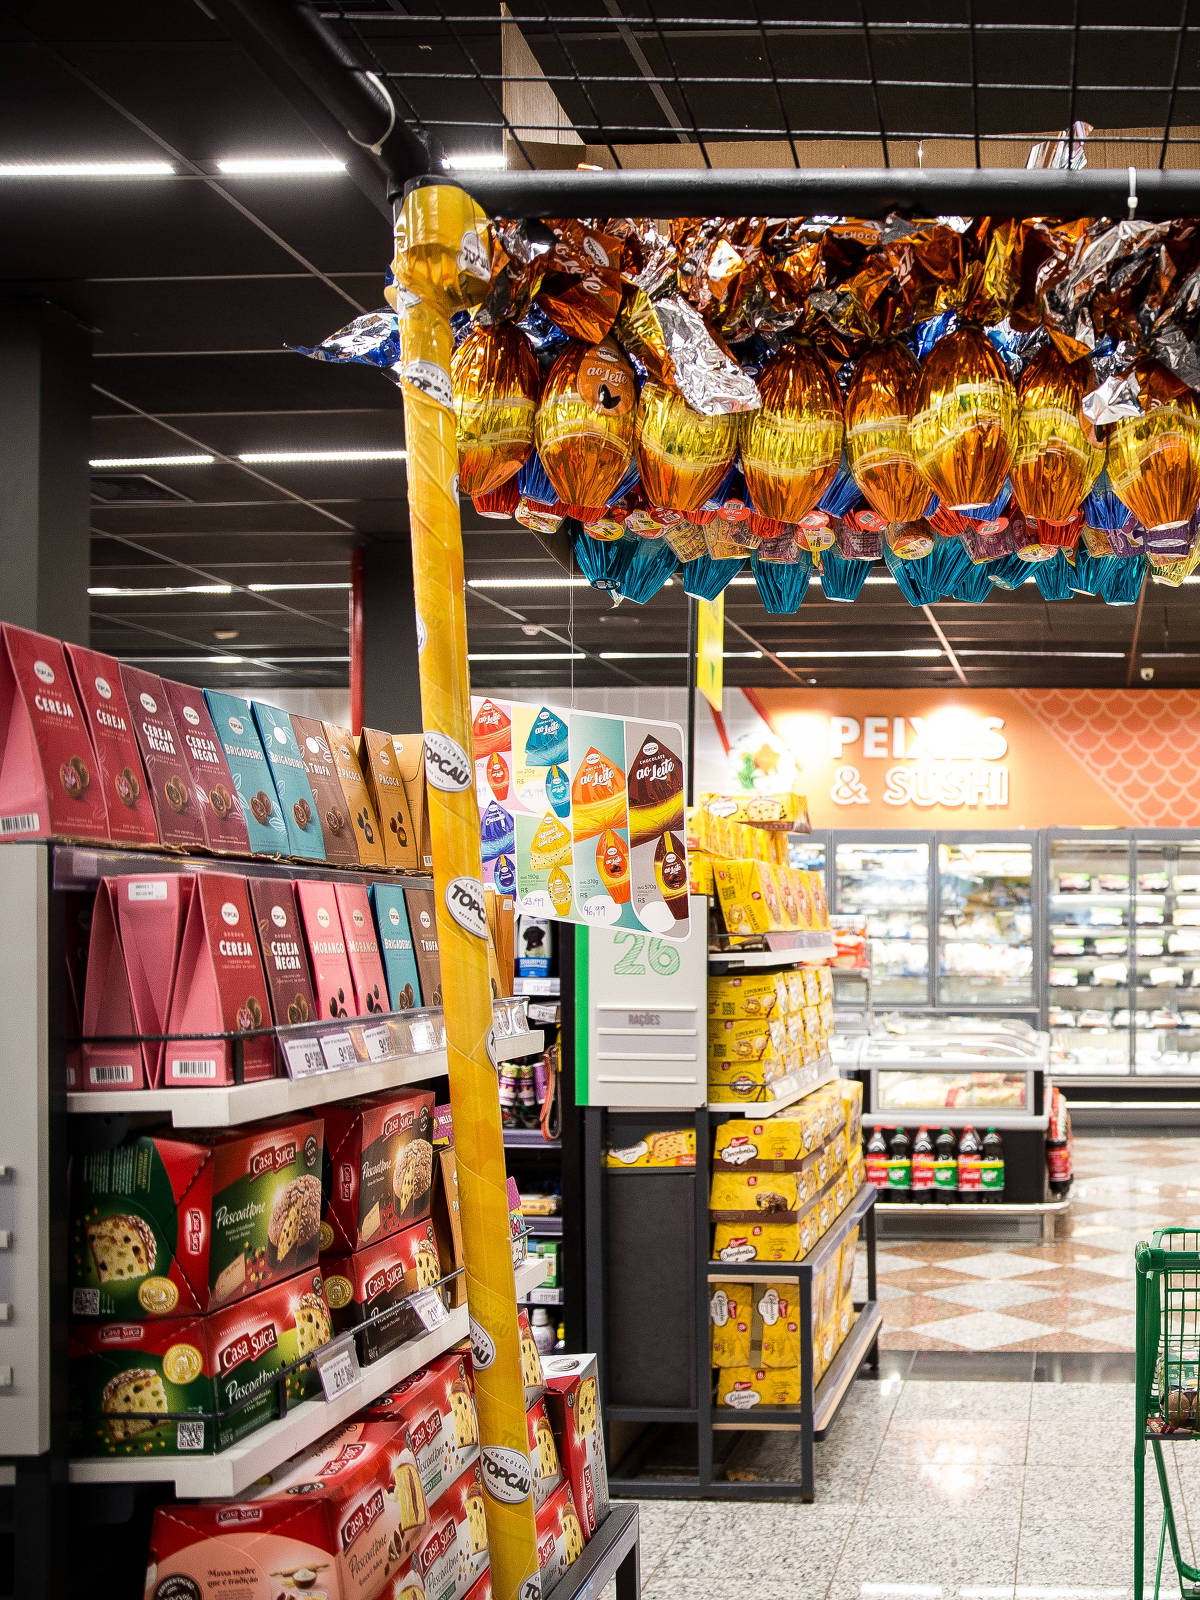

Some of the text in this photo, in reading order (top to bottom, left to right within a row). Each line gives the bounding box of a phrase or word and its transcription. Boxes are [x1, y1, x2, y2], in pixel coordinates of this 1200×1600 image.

[587, 367, 628, 386] ao Leite
[35, 695, 74, 718] CEREJA
[96, 709, 127, 732] CEREJA
[142, 722, 174, 742] CEREJA
[831, 716, 1008, 760] PEIXS
[148, 735, 176, 755] NEGRA
[185, 735, 217, 752] CEREJA
[224, 743, 264, 761] BRIGADEIRO
[190, 746, 219, 764] NEGRA
[425, 744, 469, 784] OPCAU
[308, 762, 331, 777] TRUFA
[580, 767, 615, 787] ao Leite
[636, 759, 675, 782] ao Leite
[883, 765, 1009, 806] SUSHI
[451, 884, 487, 924] TOPC
[219, 940, 253, 957] CEREJA
[271, 941, 299, 956] CEREJA
[312, 941, 345, 955] MORANGO
[348, 940, 378, 954] MORANGO
[384, 938, 412, 950] BRIGADEIRO
[614, 931, 681, 976] 26
[274, 956, 301, 971] NEGRA
[628, 1012, 661, 1027] RAÇÕES
[368, 1275, 385, 1297] Casa
[222, 1340, 249, 1368] Casa
[483, 1452, 531, 1494] TOPCAU
[344, 1515, 365, 1545] Casa
[422, 1544, 440, 1566] Casa
